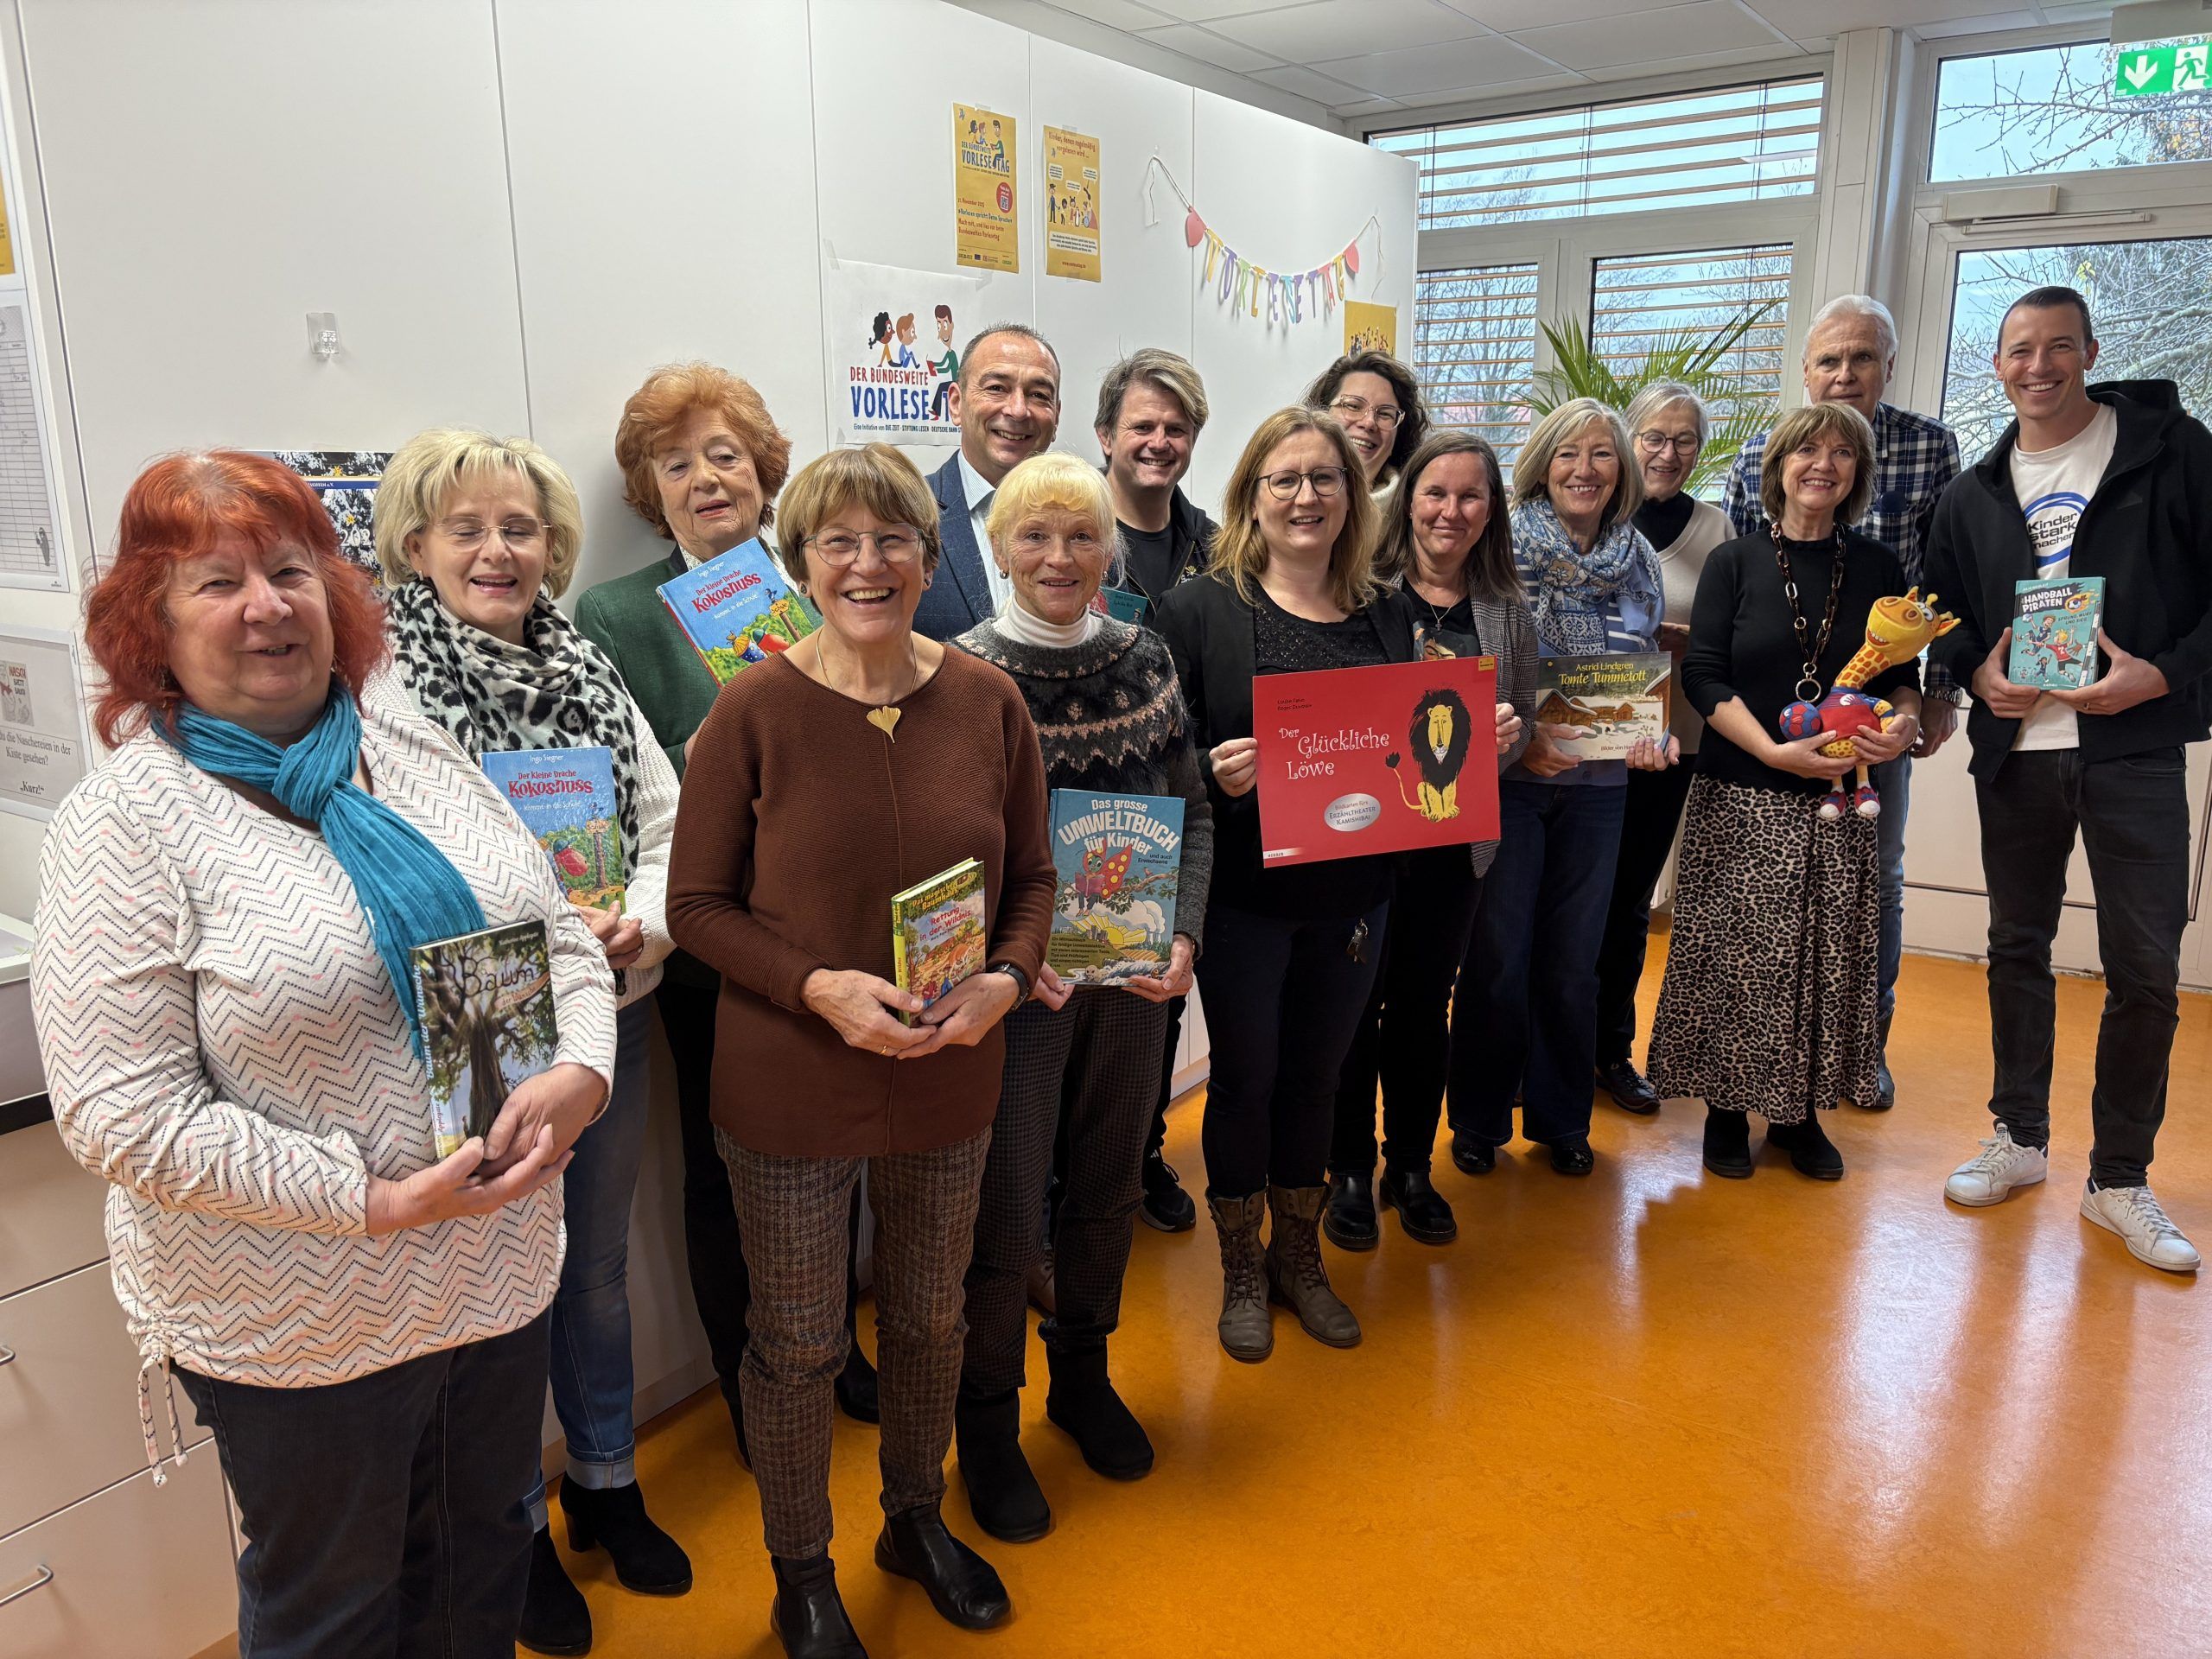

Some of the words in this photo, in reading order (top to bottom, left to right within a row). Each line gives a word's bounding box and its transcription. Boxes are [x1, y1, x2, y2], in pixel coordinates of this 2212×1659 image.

[850, 366, 868, 382] DER
[871, 367, 929, 386] BUNDESWEITE
[862, 423, 878, 432] Initiative
[2027, 513, 2077, 533] Kinder
[2029, 522, 2077, 542] stark
[707, 562, 725, 573] Siegner
[696, 587, 707, 596] Der
[722, 569, 742, 583] Drache
[2024, 588, 2073, 603] HANDBALL
[1600, 662, 1634, 671] Lindgren
[1559, 674, 1590, 684] Tomte
[1592, 671, 1646, 683] Tummetott
[6, 731, 16, 743] die
[16, 734, 52, 753] Naschereien
[53, 741, 60, 753] in
[60, 743, 71, 755] der
[1279, 728, 1300, 740] Der
[1298, 728, 1389, 759] Glückliche
[5, 747, 22, 760] Kiste
[22, 753, 48, 767] gesehen?
[530, 755, 543, 764] Ingo
[543, 753, 564, 762] Siegner
[1286, 760, 1335, 780] Löwe
[1091, 799, 1111, 810] Das
[1113, 798, 1147, 812] grosse
[1058, 810, 1181, 853] UMWELTBUCH
[1084, 835, 1105, 852] für
[1106, 833, 1154, 855] Kinder
[912, 897, 924, 907] Das
[930, 907, 959, 926] Rettung
[930, 925, 942, 936] der
[944, 910, 971, 928] Wildnis
[421, 1022, 429, 1042] der
[423, 1046, 434, 1080] Baum
